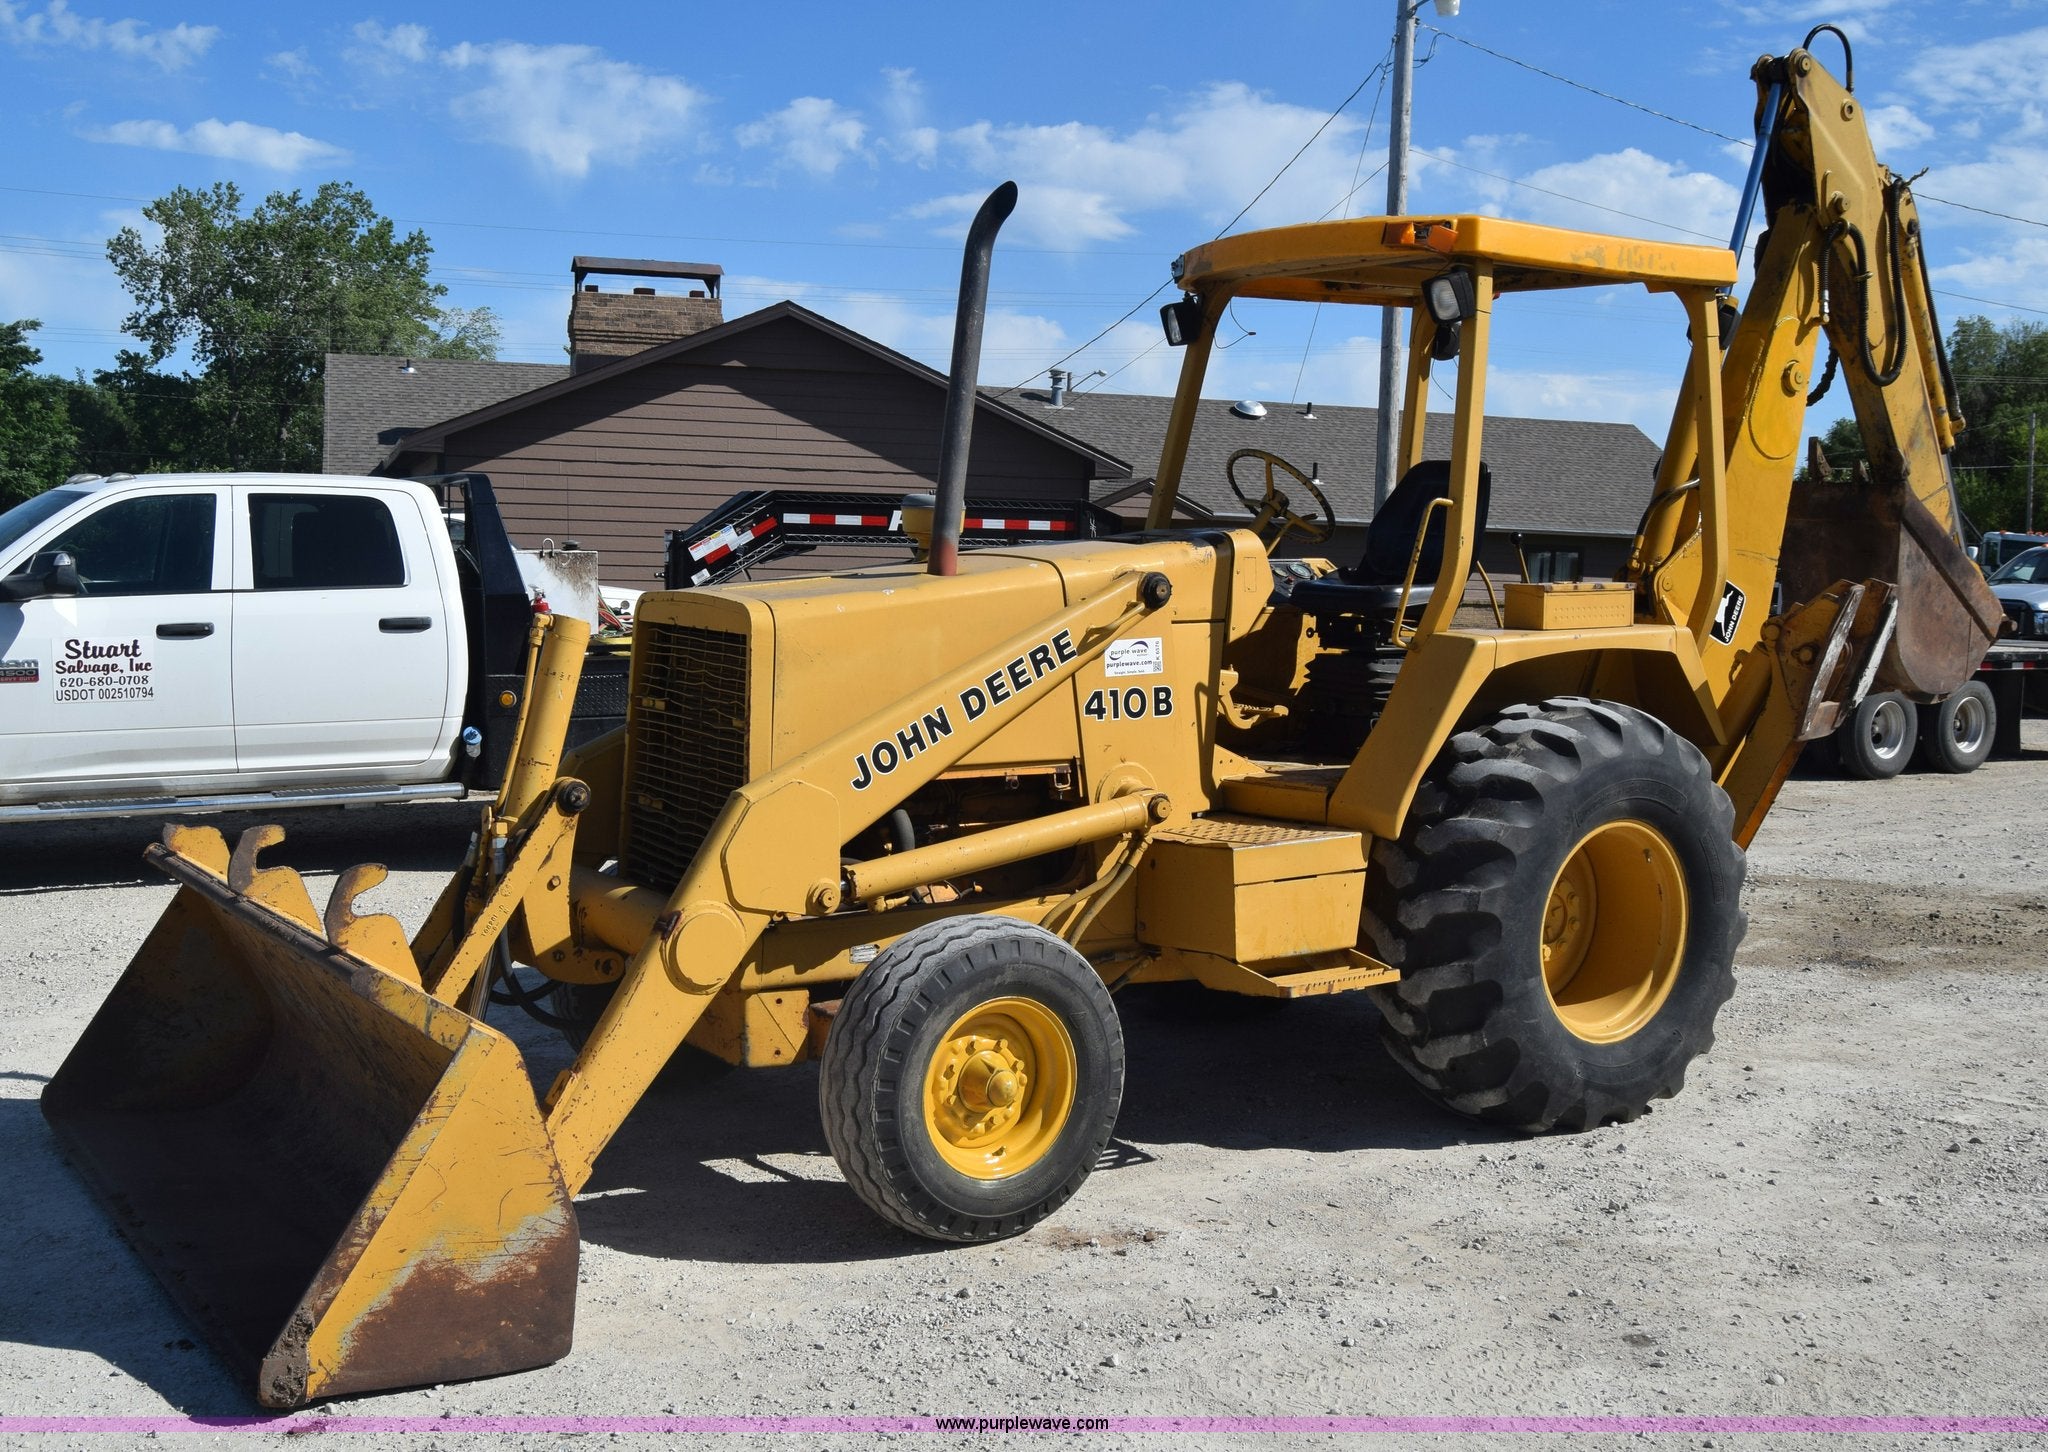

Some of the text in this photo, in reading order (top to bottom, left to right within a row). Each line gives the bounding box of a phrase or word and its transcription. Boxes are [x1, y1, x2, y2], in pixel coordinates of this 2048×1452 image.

[1725, 595, 1743, 642] JOHN DEERE
[65, 639, 142, 660] Stuart
[55, 658, 153, 675] Salvage, Inc
[1107, 660, 1152, 668] purplewave.com
[60, 675, 149, 688] 620-680-0708
[56, 686, 154, 701] USDOT 002510794
[850, 627, 1077, 791] JOHN DEERE
